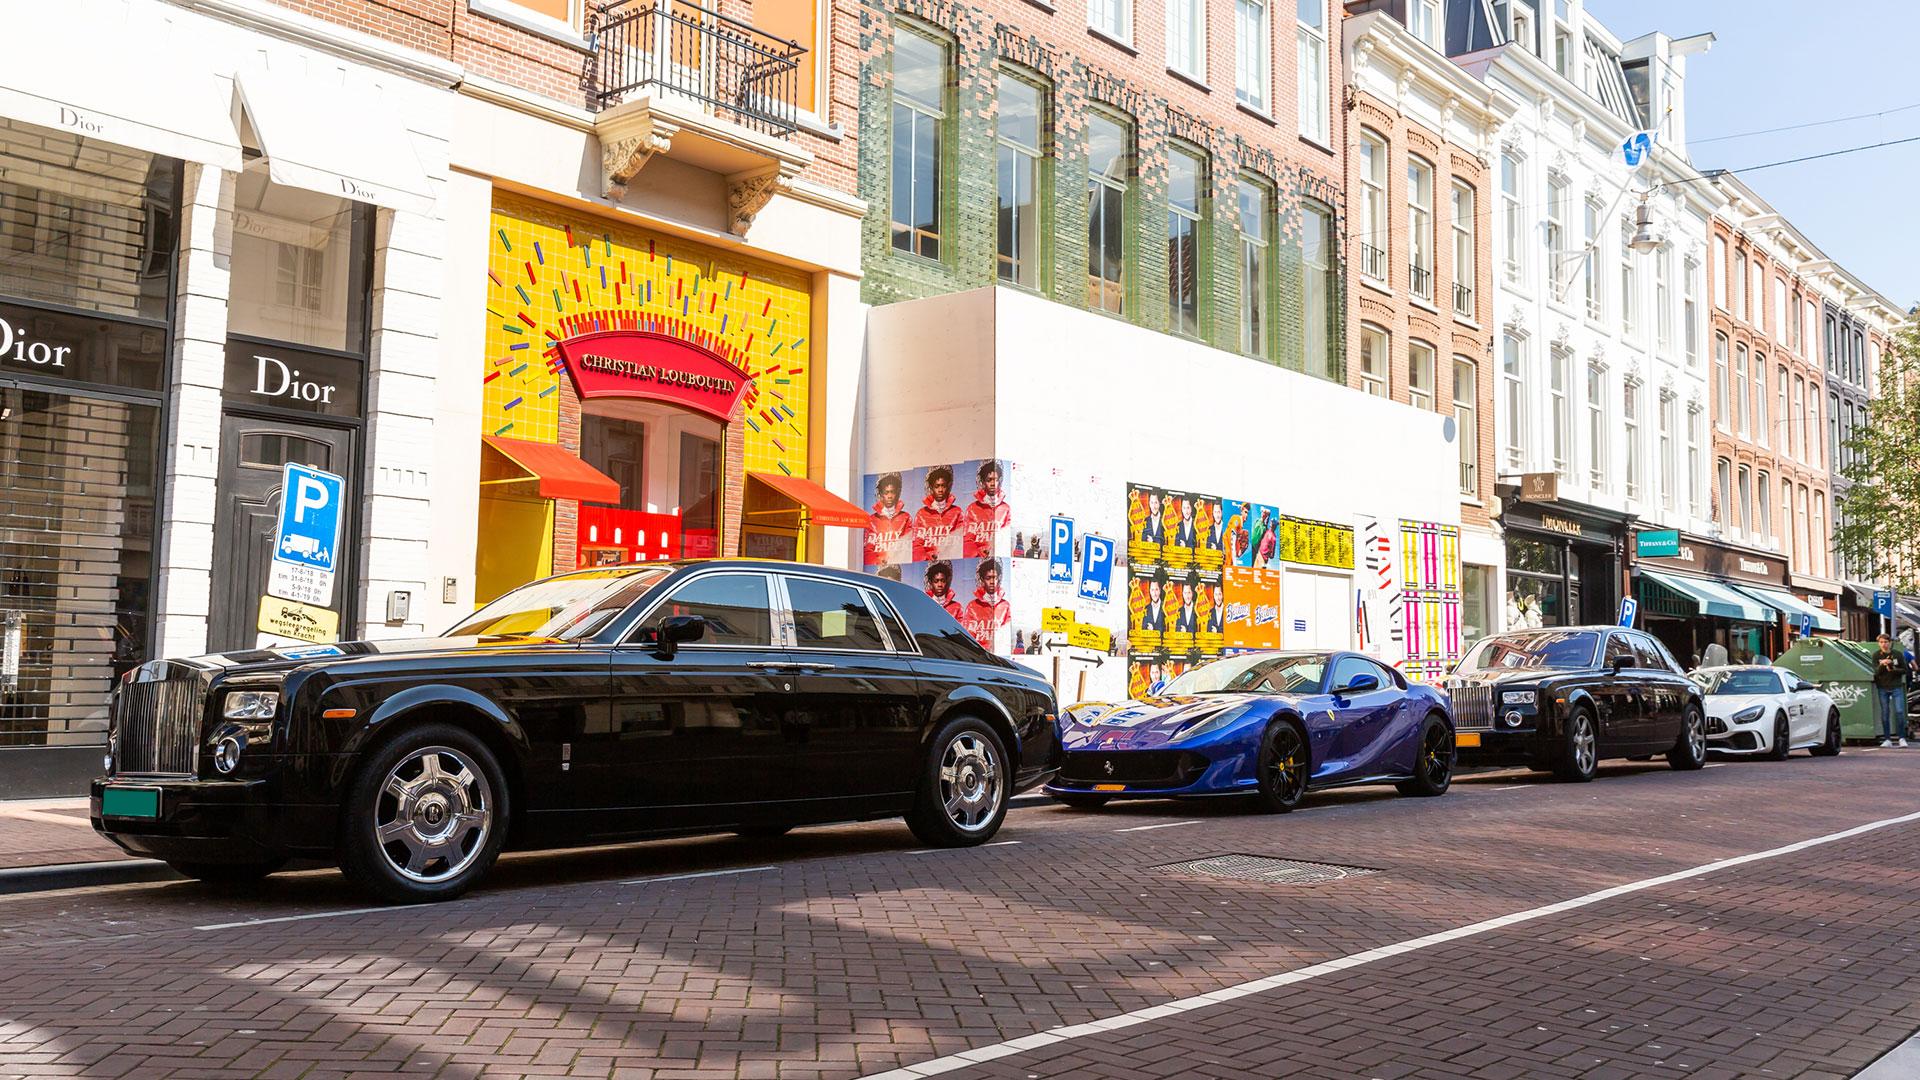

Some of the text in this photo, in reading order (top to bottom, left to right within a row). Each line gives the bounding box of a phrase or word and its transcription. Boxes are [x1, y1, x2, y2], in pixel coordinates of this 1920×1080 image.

[59, 107, 104, 133] Dior
[340, 178, 376, 200] Dior
[250, 355, 336, 404] Dior
[582, 354, 736, 394] CHRISTIAN LOUBOUTIN
[294, 475, 330, 523] P
[868, 531, 902, 545] DAILY
[917, 525, 953, 538] DAILY
[1054, 522, 1070, 556] P
[1088, 540, 1108, 573] P
[1622, 602, 1633, 621] P
